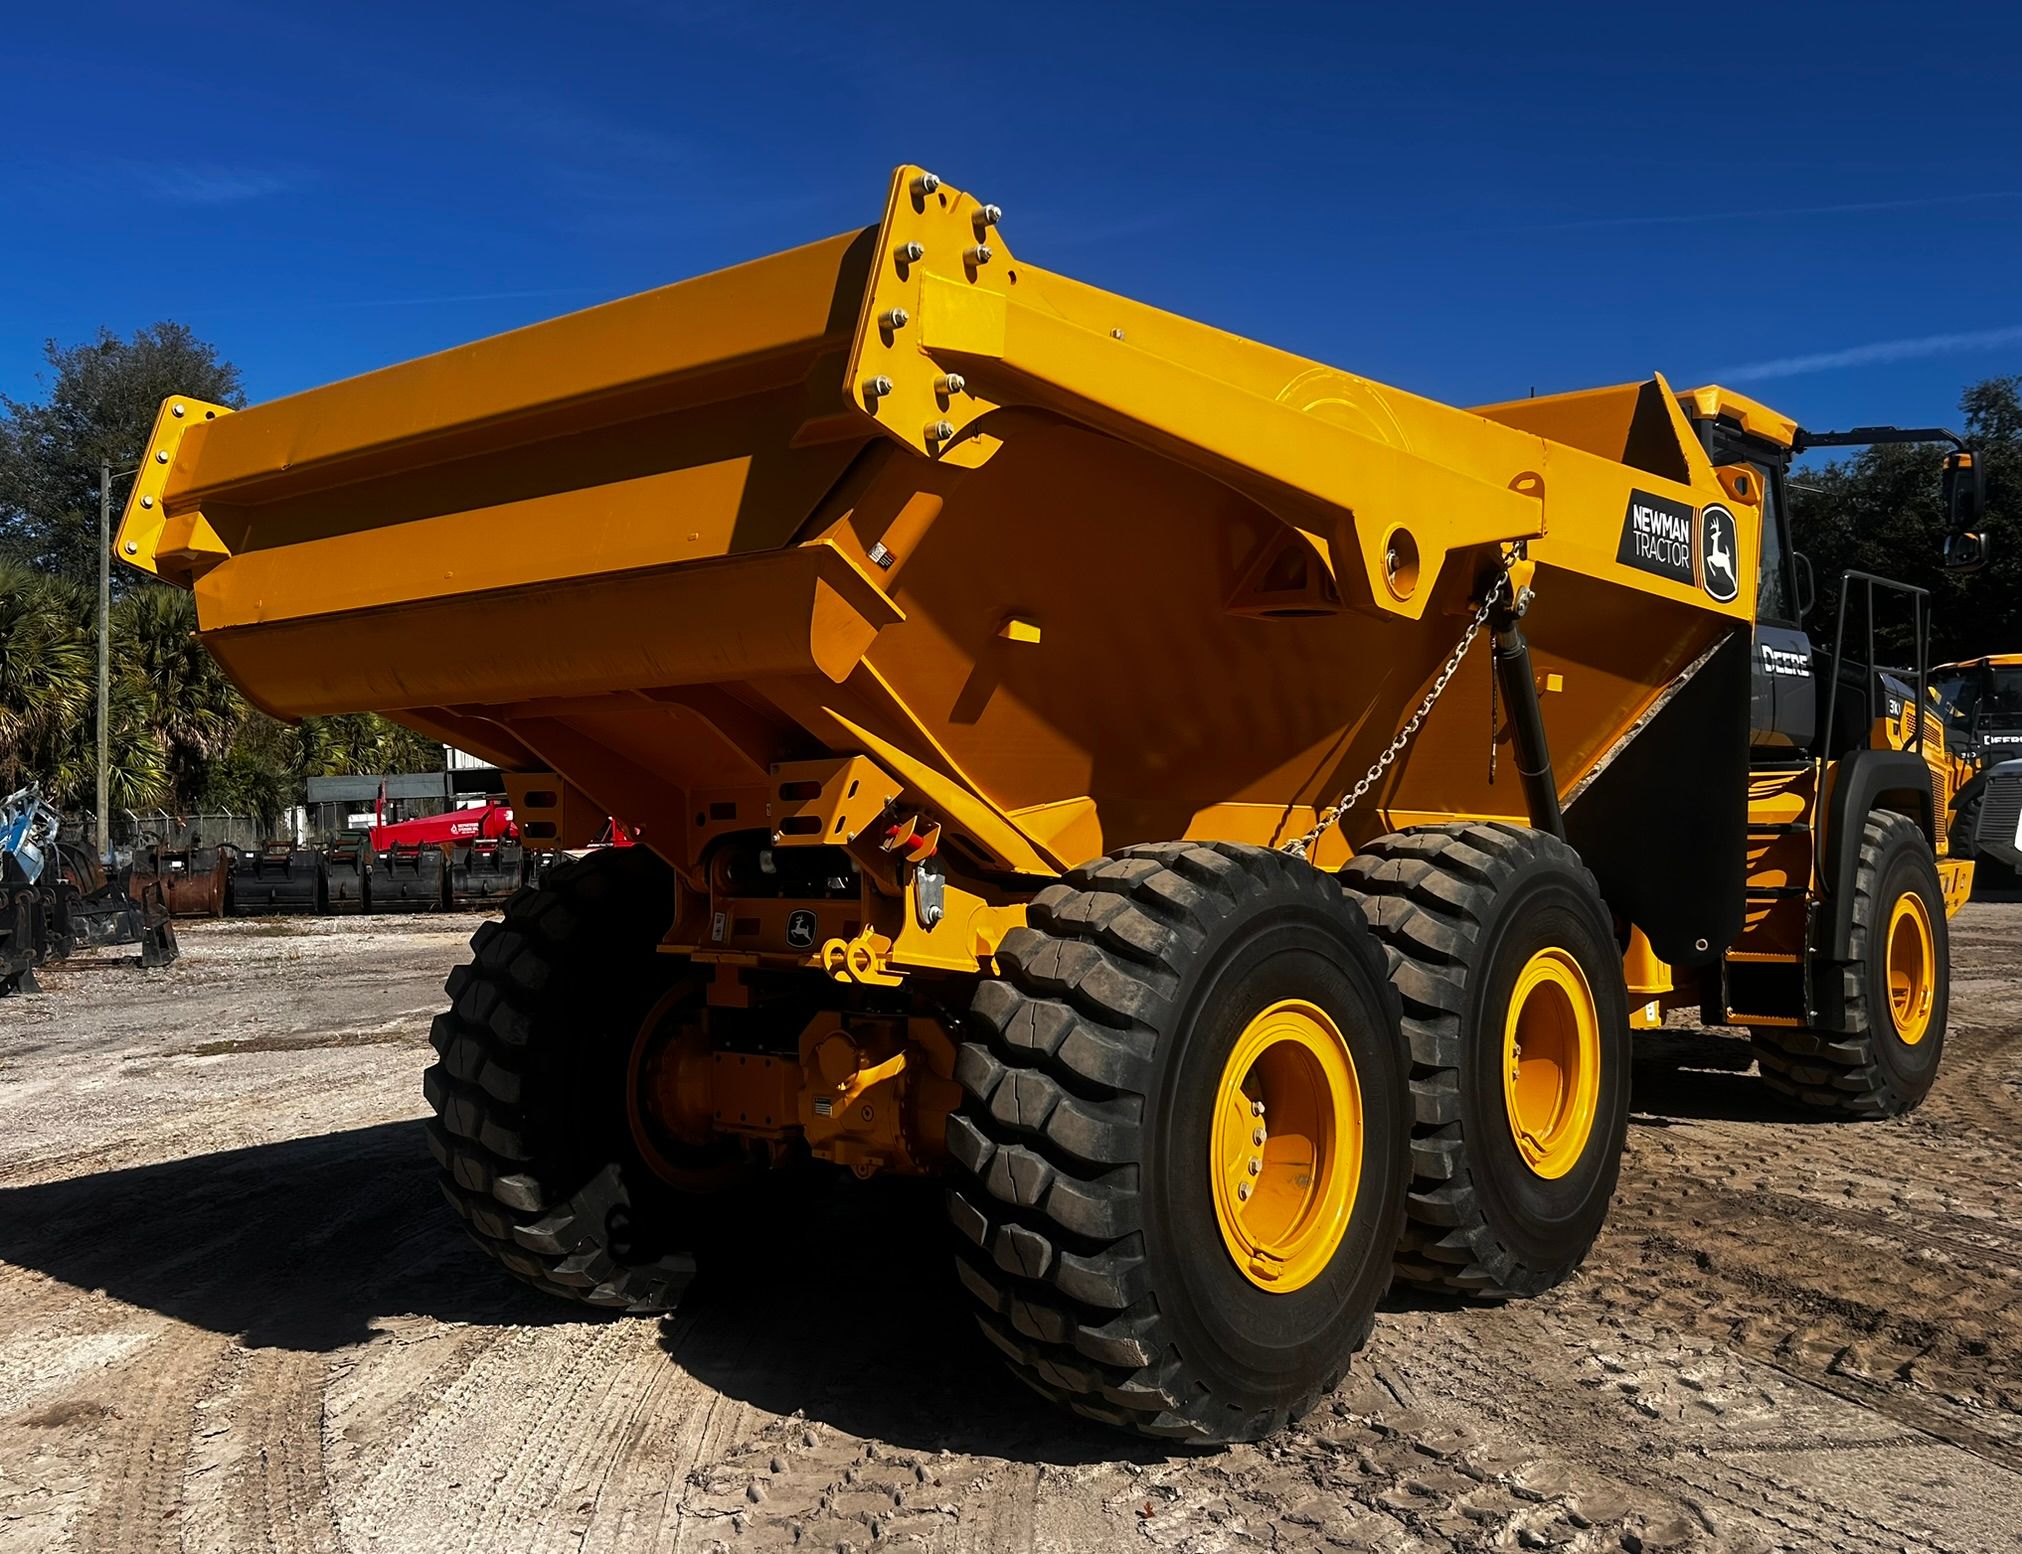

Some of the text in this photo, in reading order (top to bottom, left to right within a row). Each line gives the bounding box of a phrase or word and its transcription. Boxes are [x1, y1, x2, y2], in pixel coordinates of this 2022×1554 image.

[1633, 504, 1689, 544] NEWMAN
[1633, 530, 1690, 569] TRACTOR
[1761, 644, 1810, 677] DEERE
[1983, 735, 2022, 745] DEER
